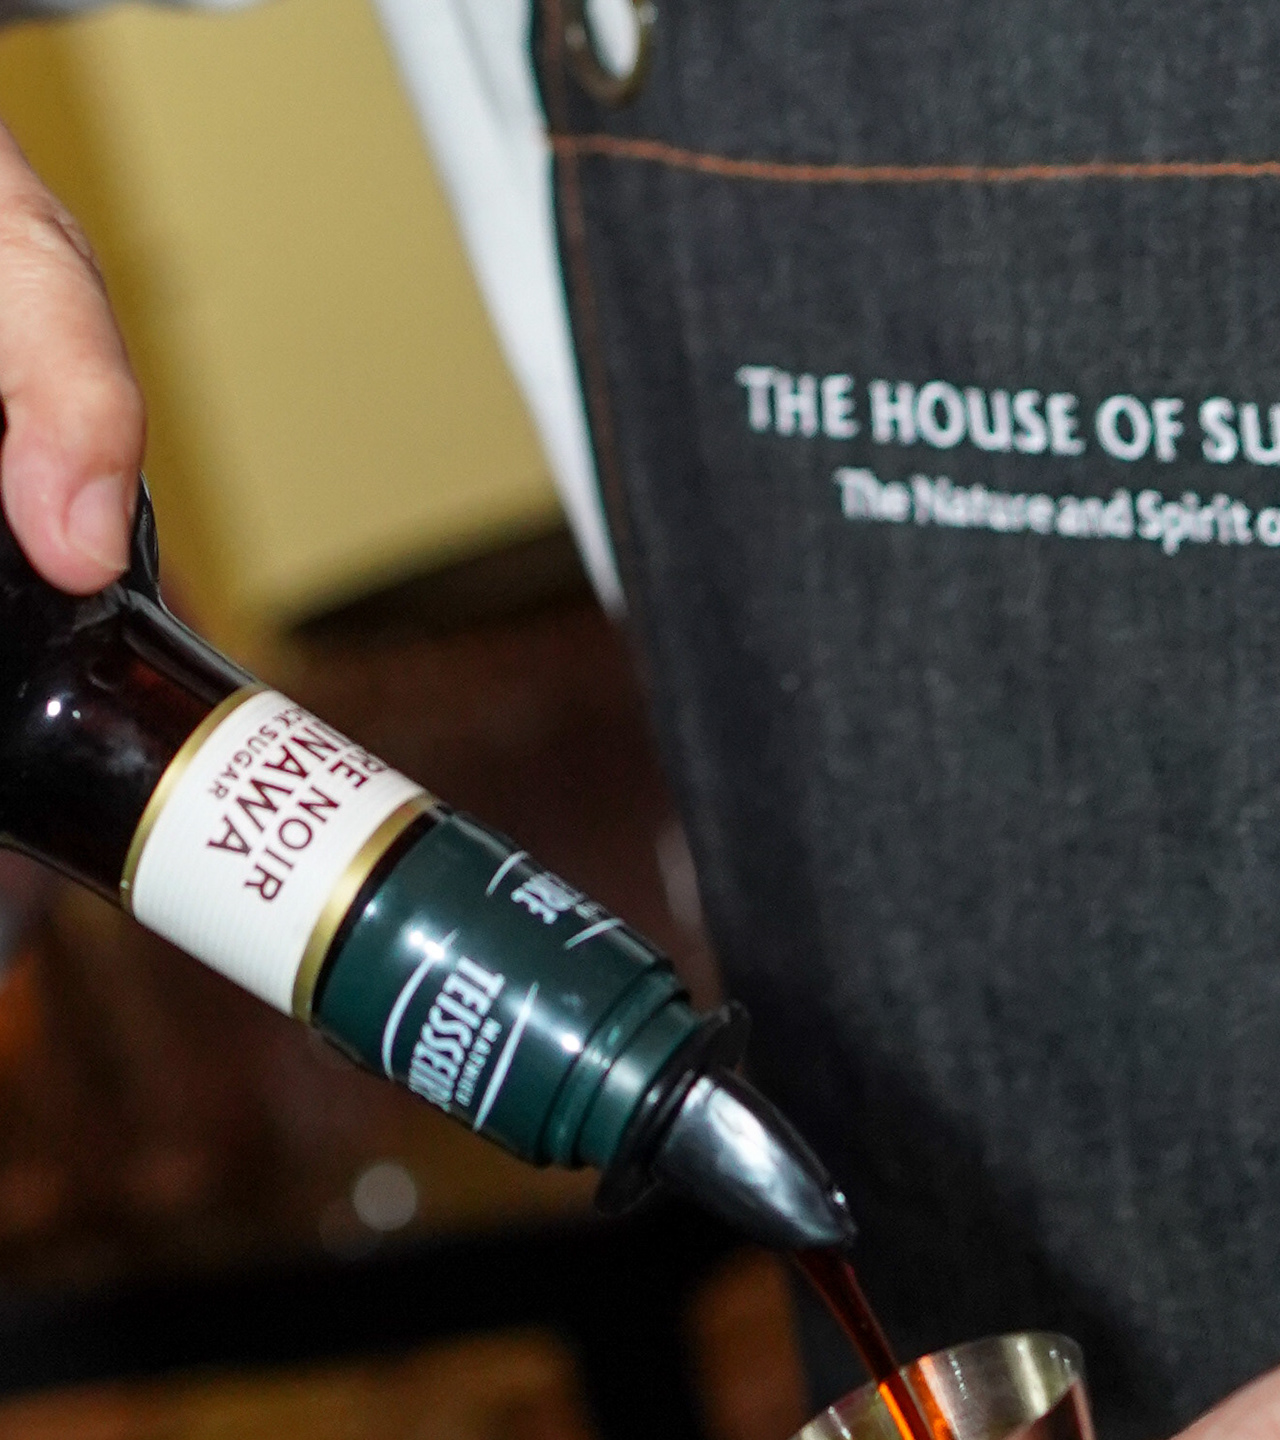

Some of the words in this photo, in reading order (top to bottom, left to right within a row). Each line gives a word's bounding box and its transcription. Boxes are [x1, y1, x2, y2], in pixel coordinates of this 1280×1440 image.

[734, 363, 860, 440] THE
[867, 378, 1087, 457] HOUSE
[1095, 393, 1185, 463] OF
[832, 465, 910, 522] The
[910, 473, 1056, 535] Nature
[1056, 488, 1134, 539] and
[1136, 488, 1254, 556] Spirit
[207, 724, 279, 800] SUGAR
[243, 785, 341, 903] NOIR
